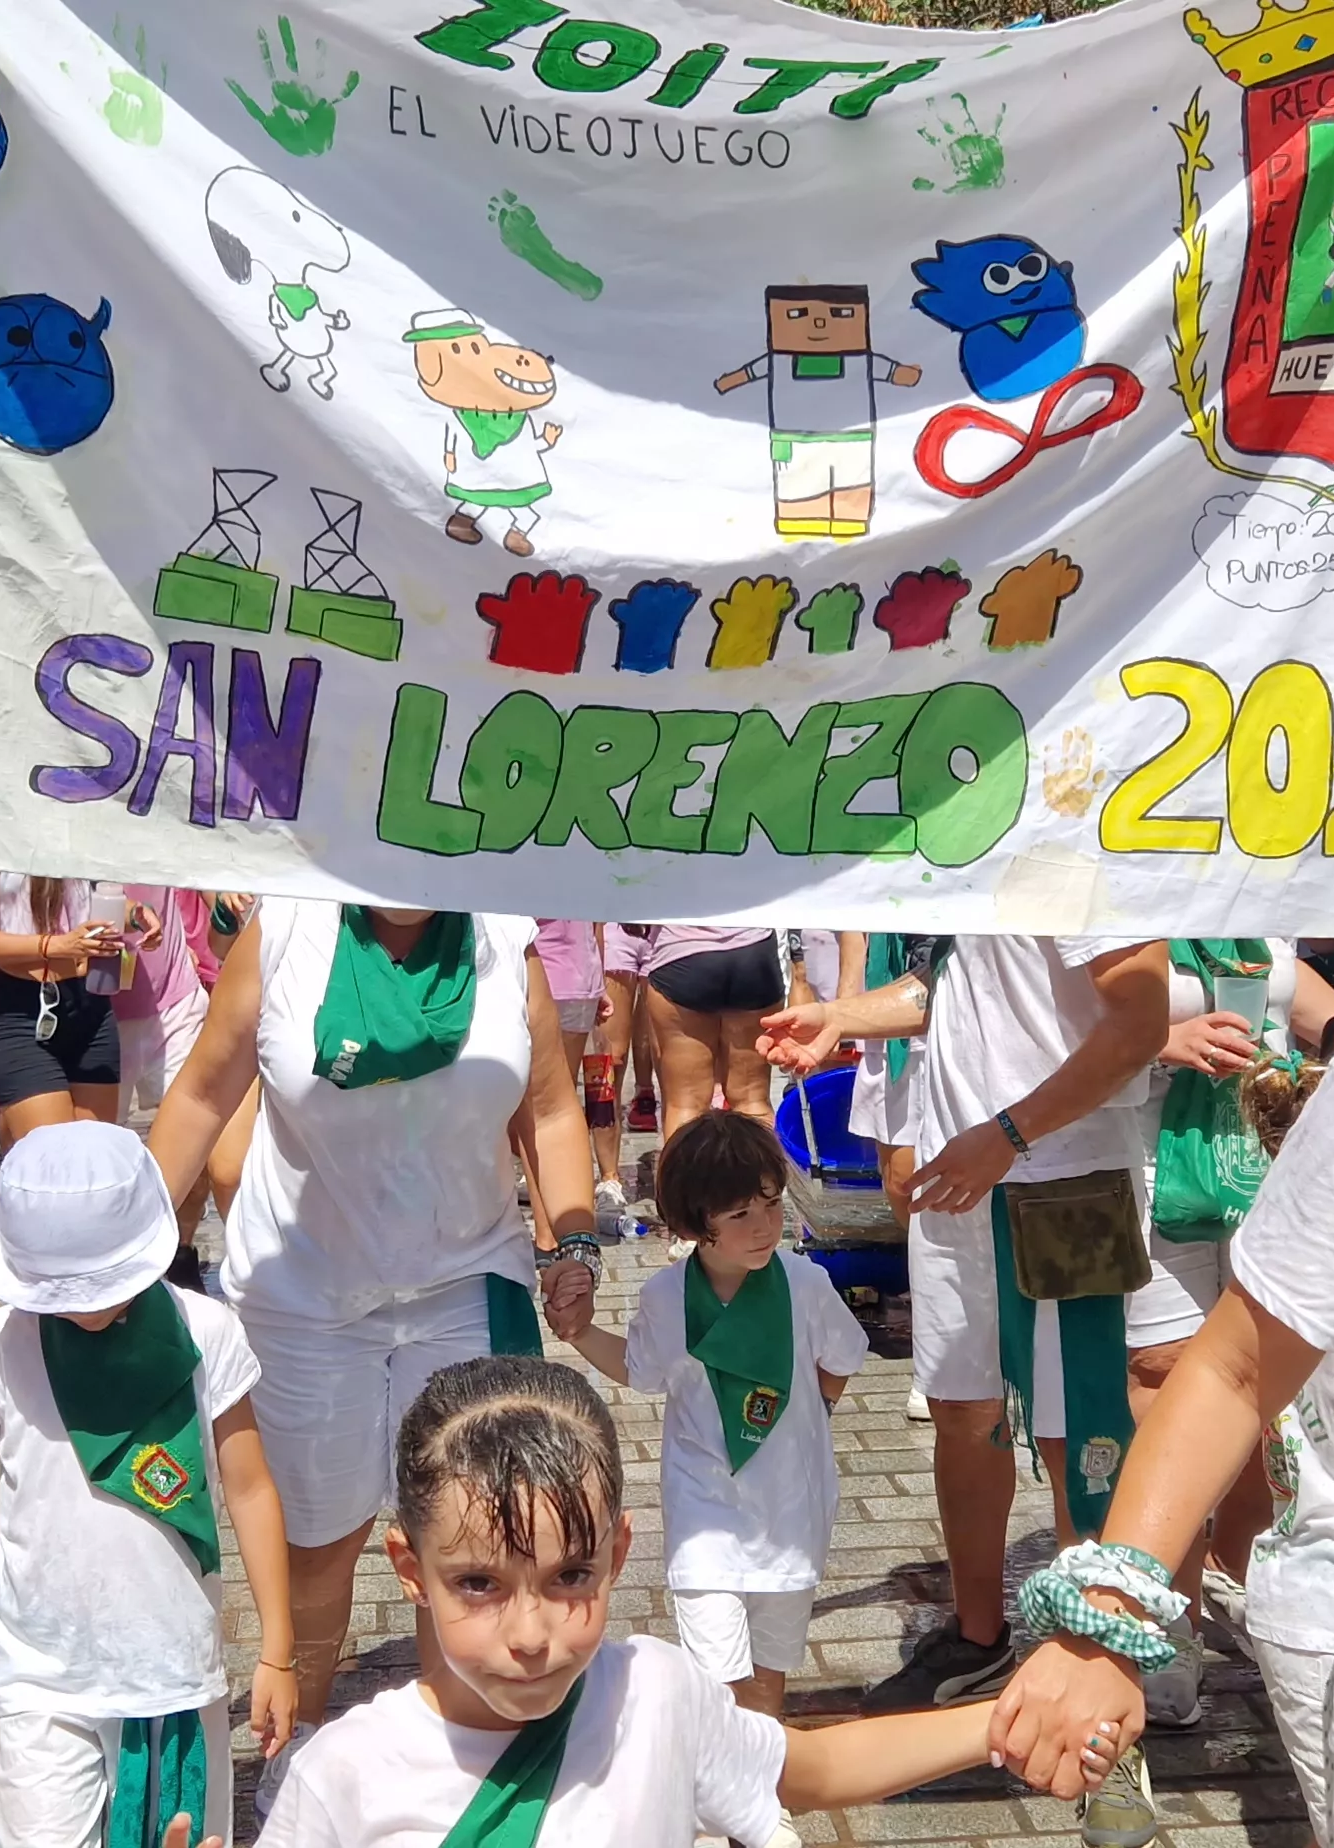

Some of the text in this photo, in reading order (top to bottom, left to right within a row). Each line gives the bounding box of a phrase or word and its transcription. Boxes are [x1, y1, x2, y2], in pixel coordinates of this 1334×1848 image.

[389, 85, 437, 139] EL
[1244, 153, 1292, 365] PEÑA
[28, 632, 322, 828] SAN
[377, 681, 1028, 868] LORENZO
